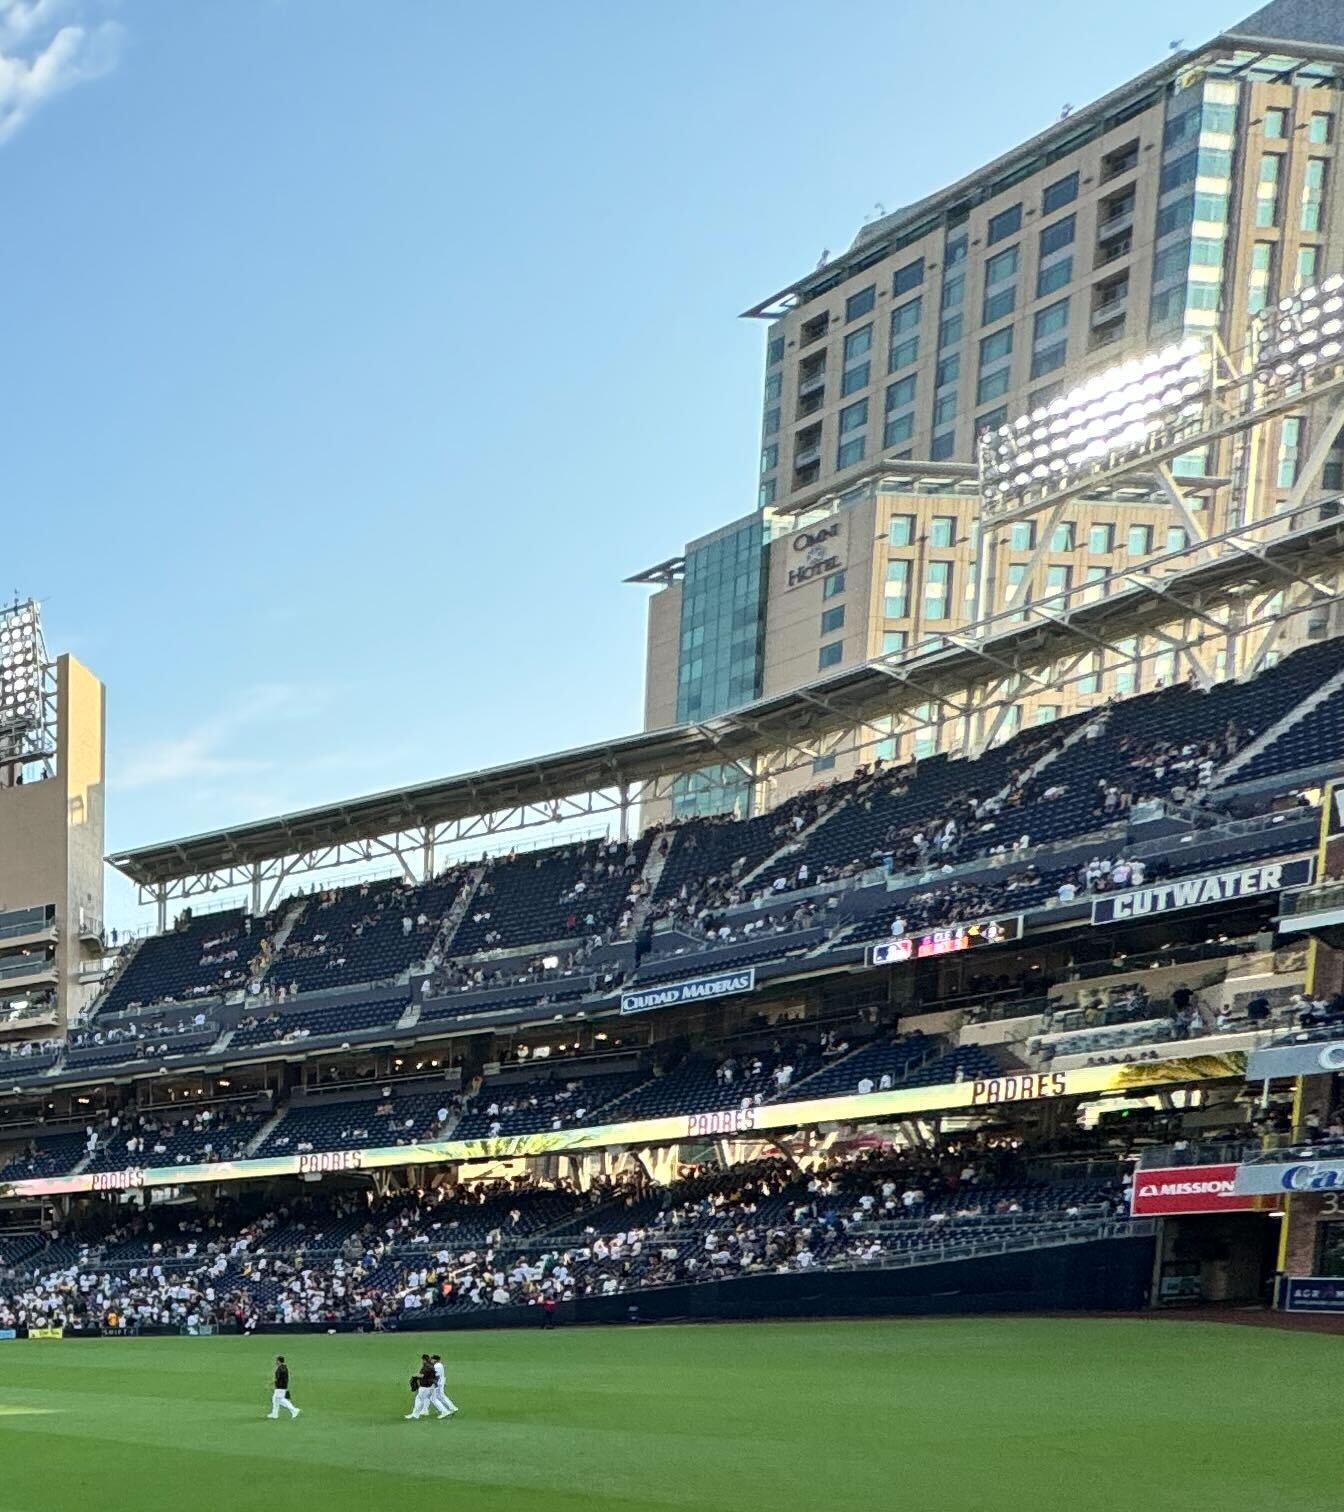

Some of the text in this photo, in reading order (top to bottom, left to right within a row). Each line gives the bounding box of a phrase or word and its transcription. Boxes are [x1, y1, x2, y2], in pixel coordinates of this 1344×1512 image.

[788, 555, 843, 587] HOTEL
[1112, 865, 1284, 919] CUTWATER
[622, 973, 752, 1011] CIUDAD MADERAS
[971, 1071, 1067, 1106] PADRES
[687, 1108, 755, 1137] PADRES
[299, 1150, 362, 1174] PADRES
[91, 1170, 145, 1191] PADRES
[1161, 1181, 1235, 1196] MISSION
